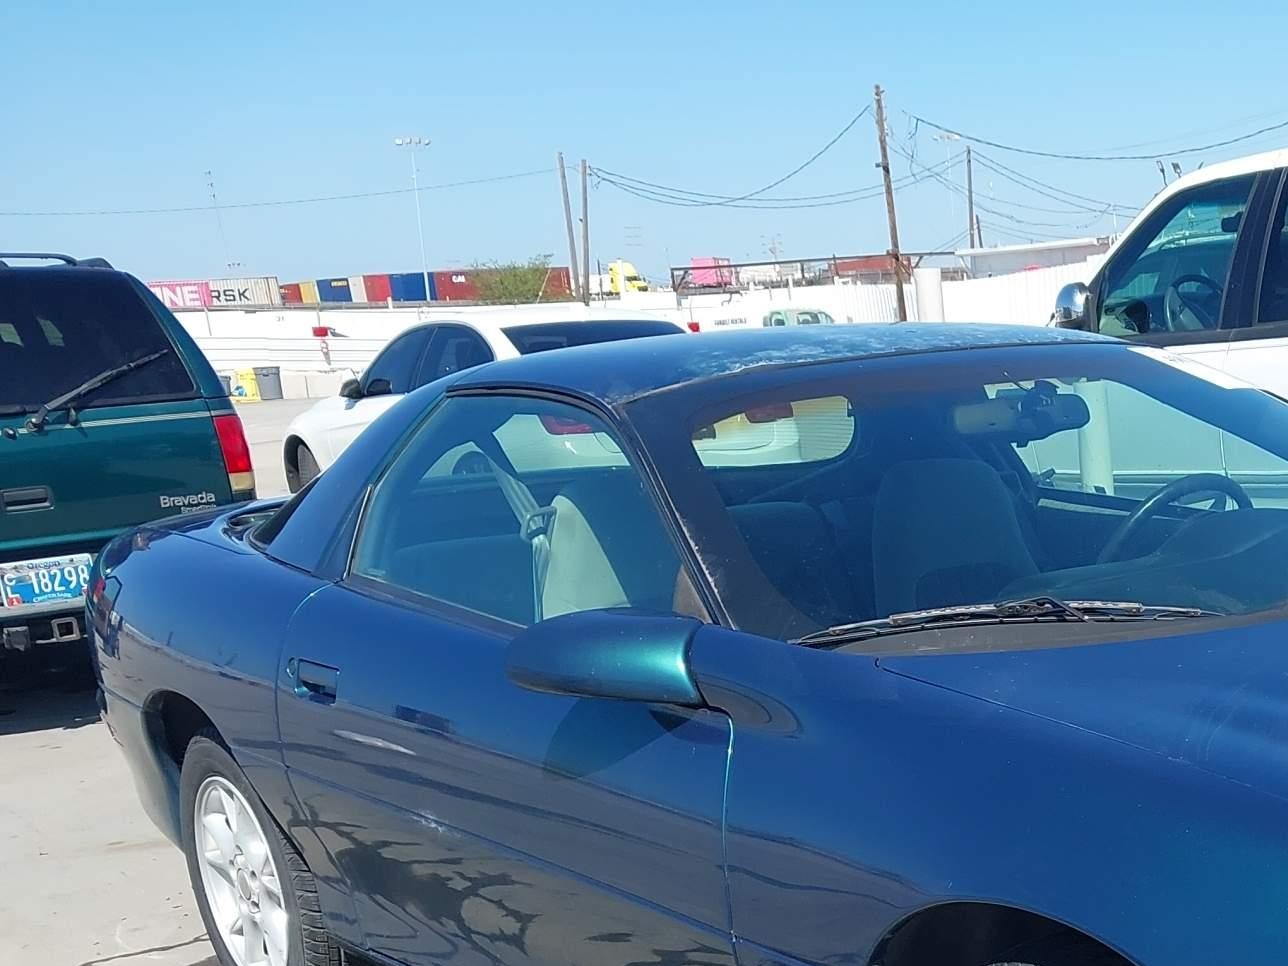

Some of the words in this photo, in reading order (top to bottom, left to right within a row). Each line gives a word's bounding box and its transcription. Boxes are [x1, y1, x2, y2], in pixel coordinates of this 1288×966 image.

[152, 286, 202, 307] NE
[160, 492, 215, 507] Bravada
[29, 565, 90, 594] 18298
